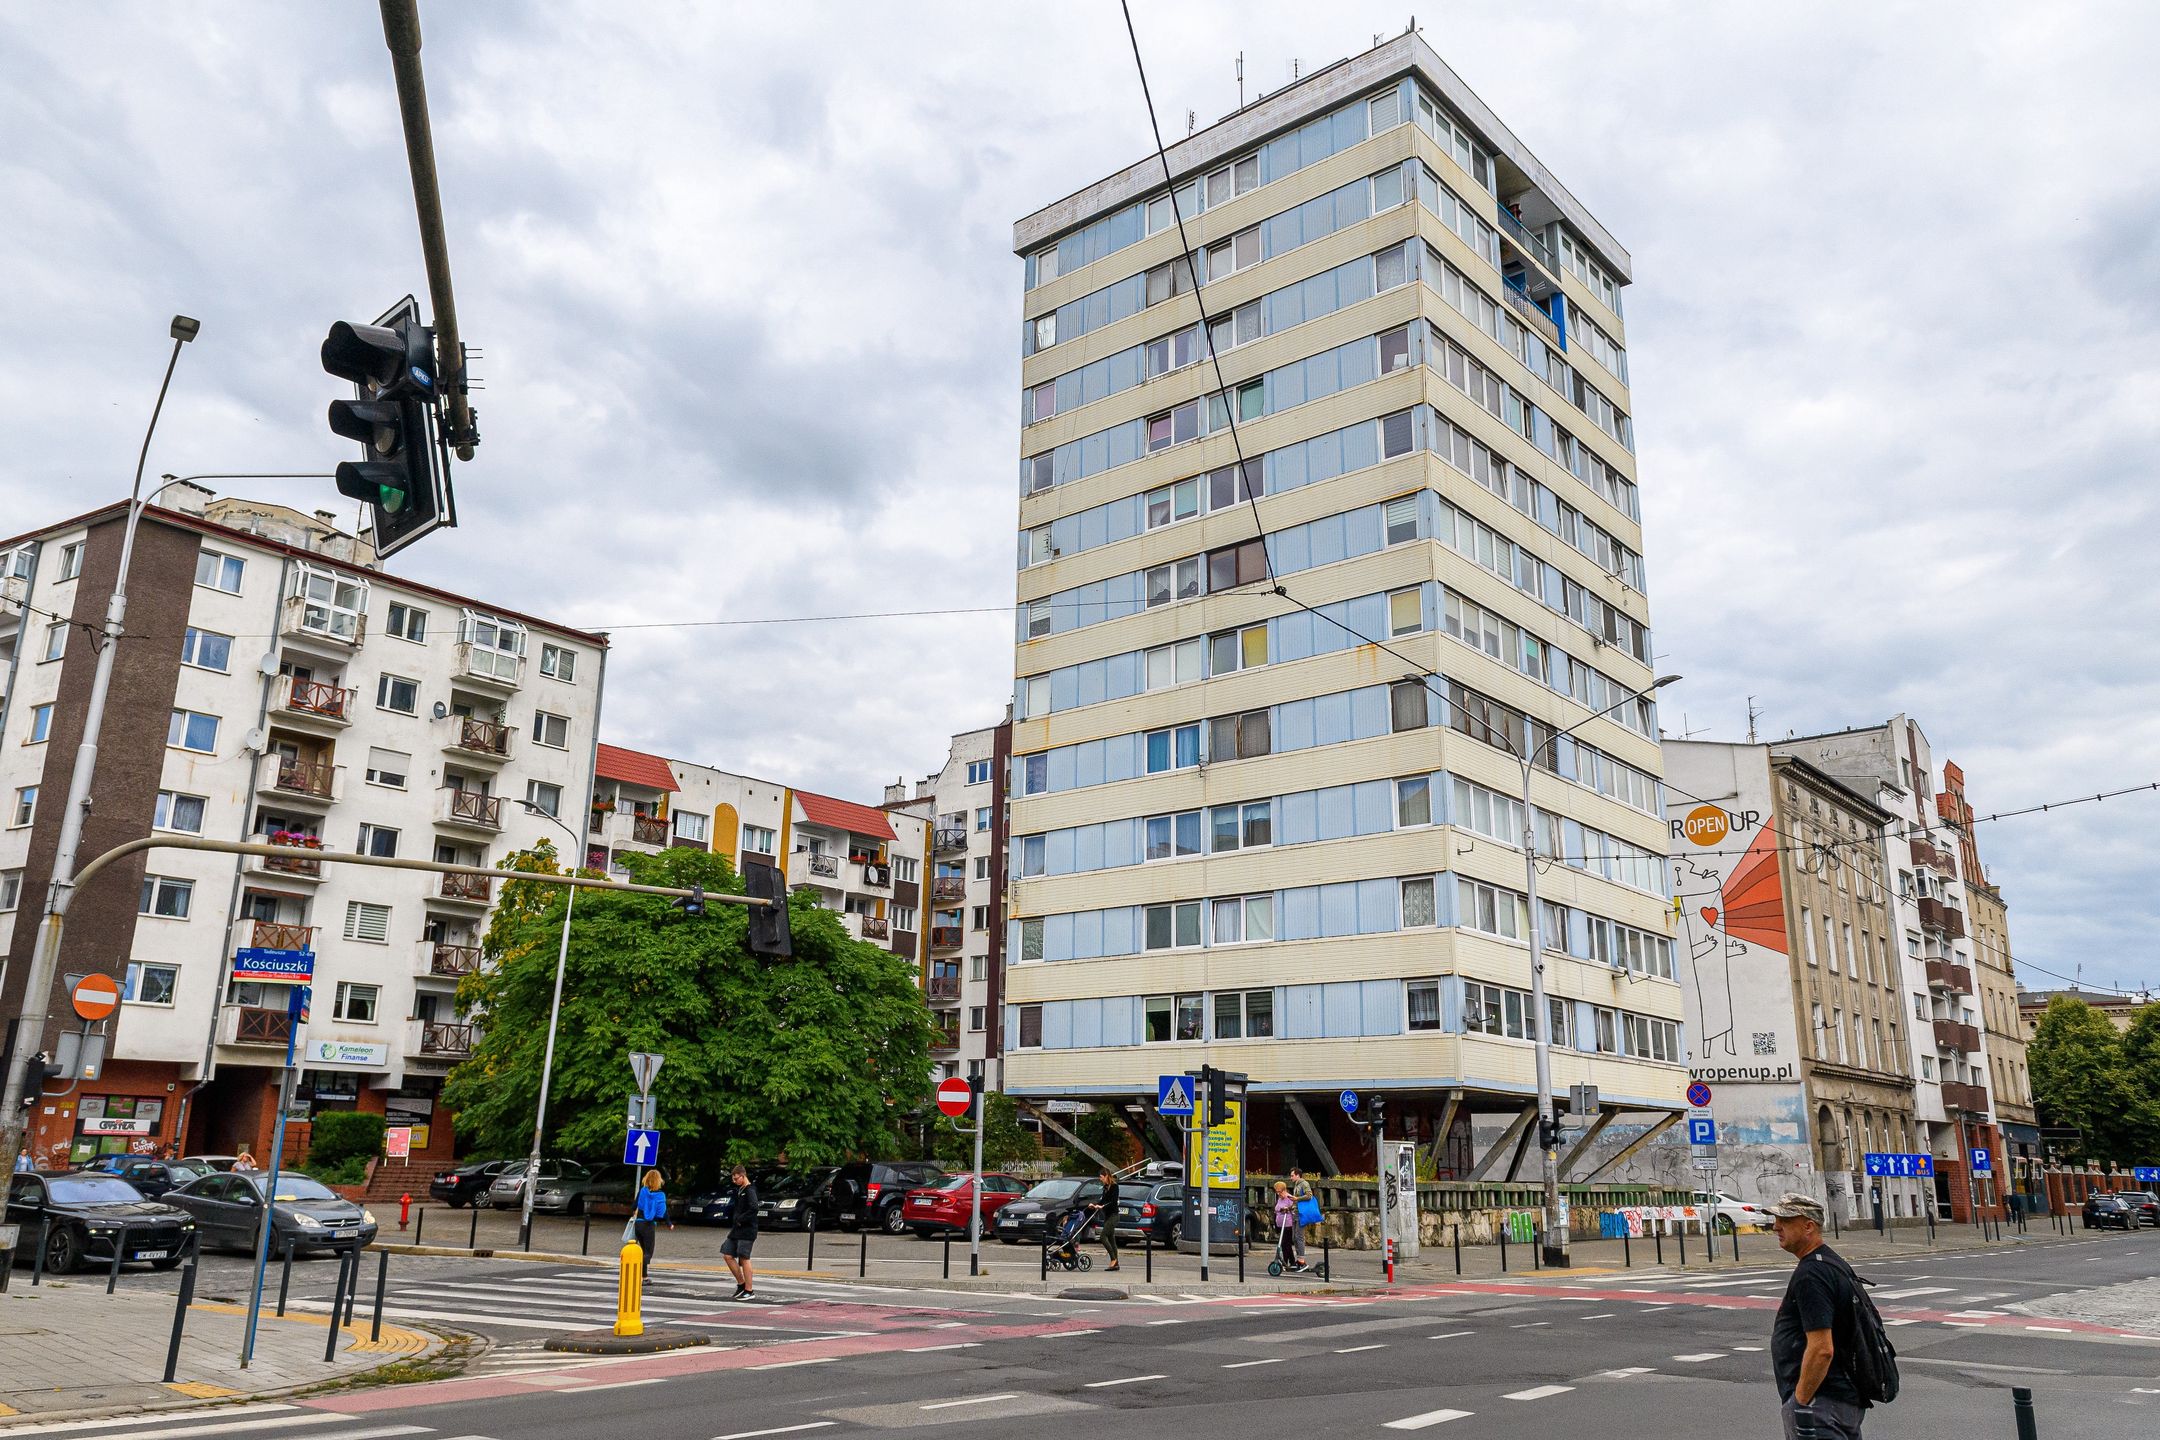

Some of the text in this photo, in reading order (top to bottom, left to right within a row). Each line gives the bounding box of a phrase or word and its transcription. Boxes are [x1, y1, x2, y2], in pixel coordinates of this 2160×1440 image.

[243, 957, 308, 972] Kościuszki
[339, 1045, 374, 1054] Kameleon
[340, 1053, 368, 1062] Finanse
[1695, 1122, 1709, 1141] P
[1975, 1150, 1986, 1164] P
